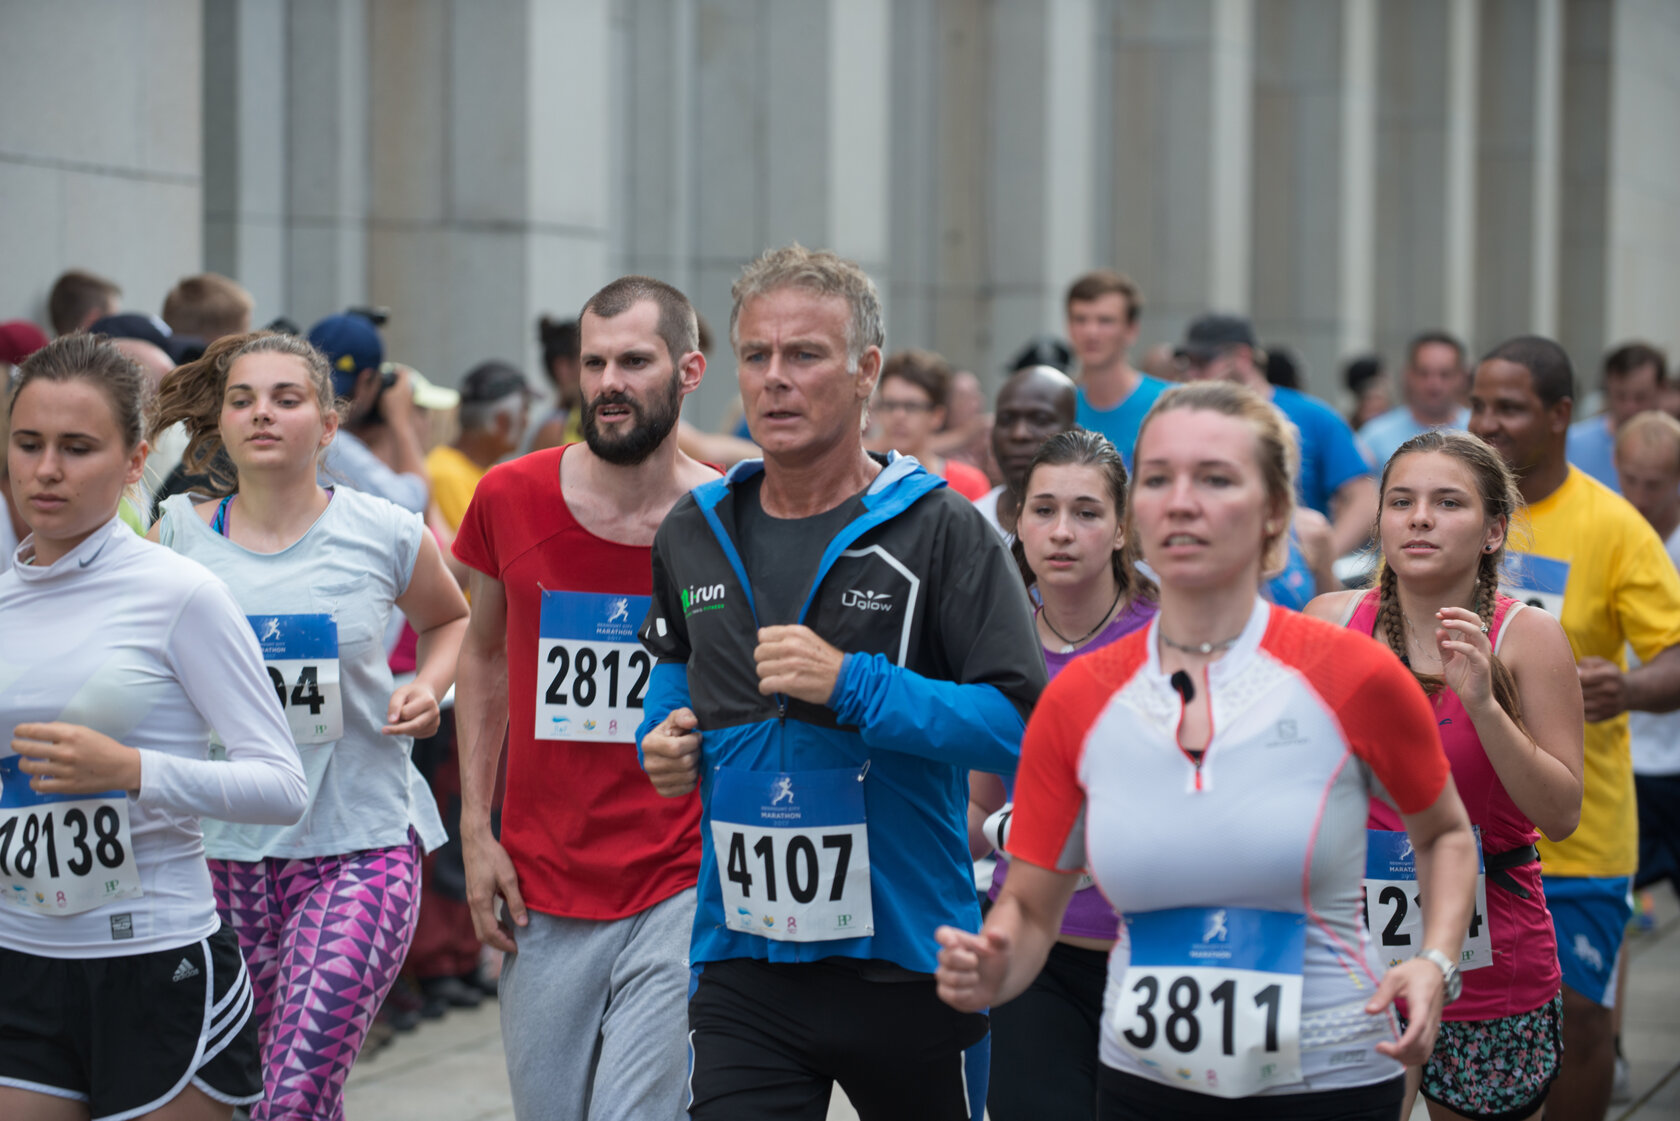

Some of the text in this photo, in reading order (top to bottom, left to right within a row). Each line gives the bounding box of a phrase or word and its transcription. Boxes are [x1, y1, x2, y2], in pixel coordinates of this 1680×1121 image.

[841, 592, 893, 612] Uglow
[596, 628, 633, 636] MARATHON
[545, 645, 651, 709] 2812
[760, 811, 802, 820] MARATHON
[0, 805, 125, 878] 18138
[727, 832, 853, 904] 4107
[1189, 950, 1232, 959] MARATHON
[1123, 975, 1282, 1056] 3811
